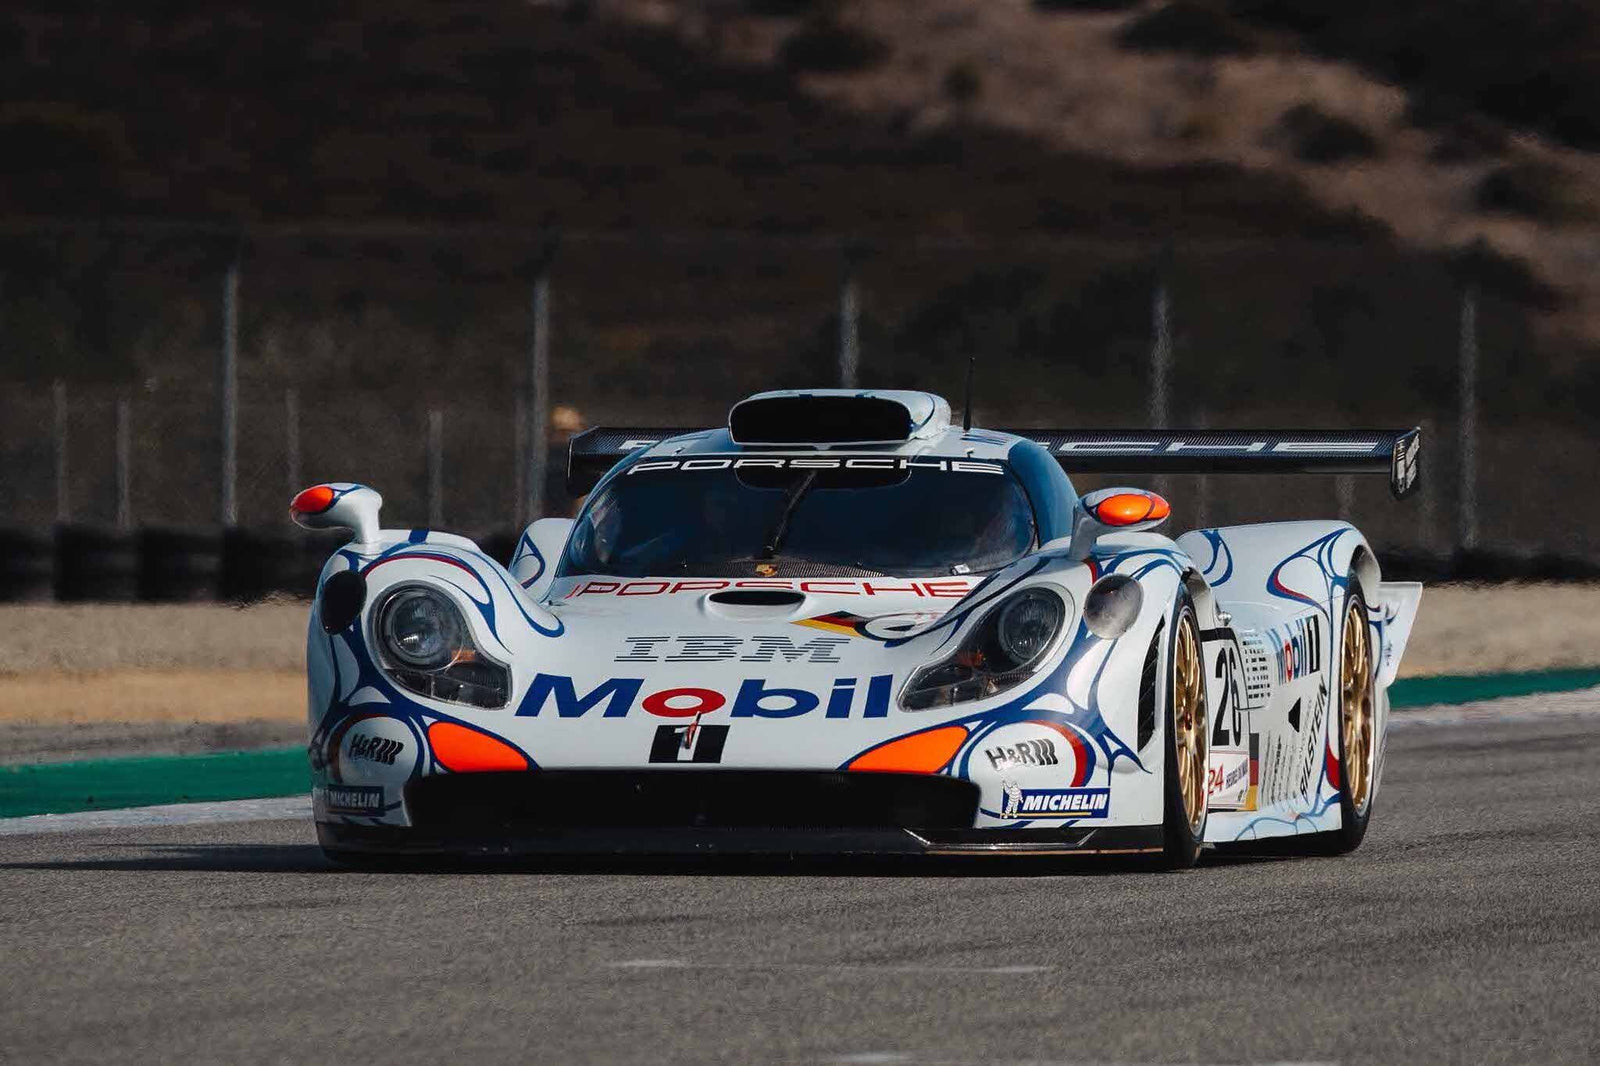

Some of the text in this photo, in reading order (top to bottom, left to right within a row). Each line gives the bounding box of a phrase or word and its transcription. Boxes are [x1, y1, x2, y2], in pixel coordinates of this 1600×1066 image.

[626, 458, 1005, 475] PORSCHE
[614, 635, 852, 664] IBM
[514, 673, 893, 719] Mobil
[1212, 647, 1241, 747] 26
[1300, 672, 1328, 806] BILSTEIN
[985, 740, 1036, 771] H&R
[1022, 793, 1108, 812] MICHELIN
